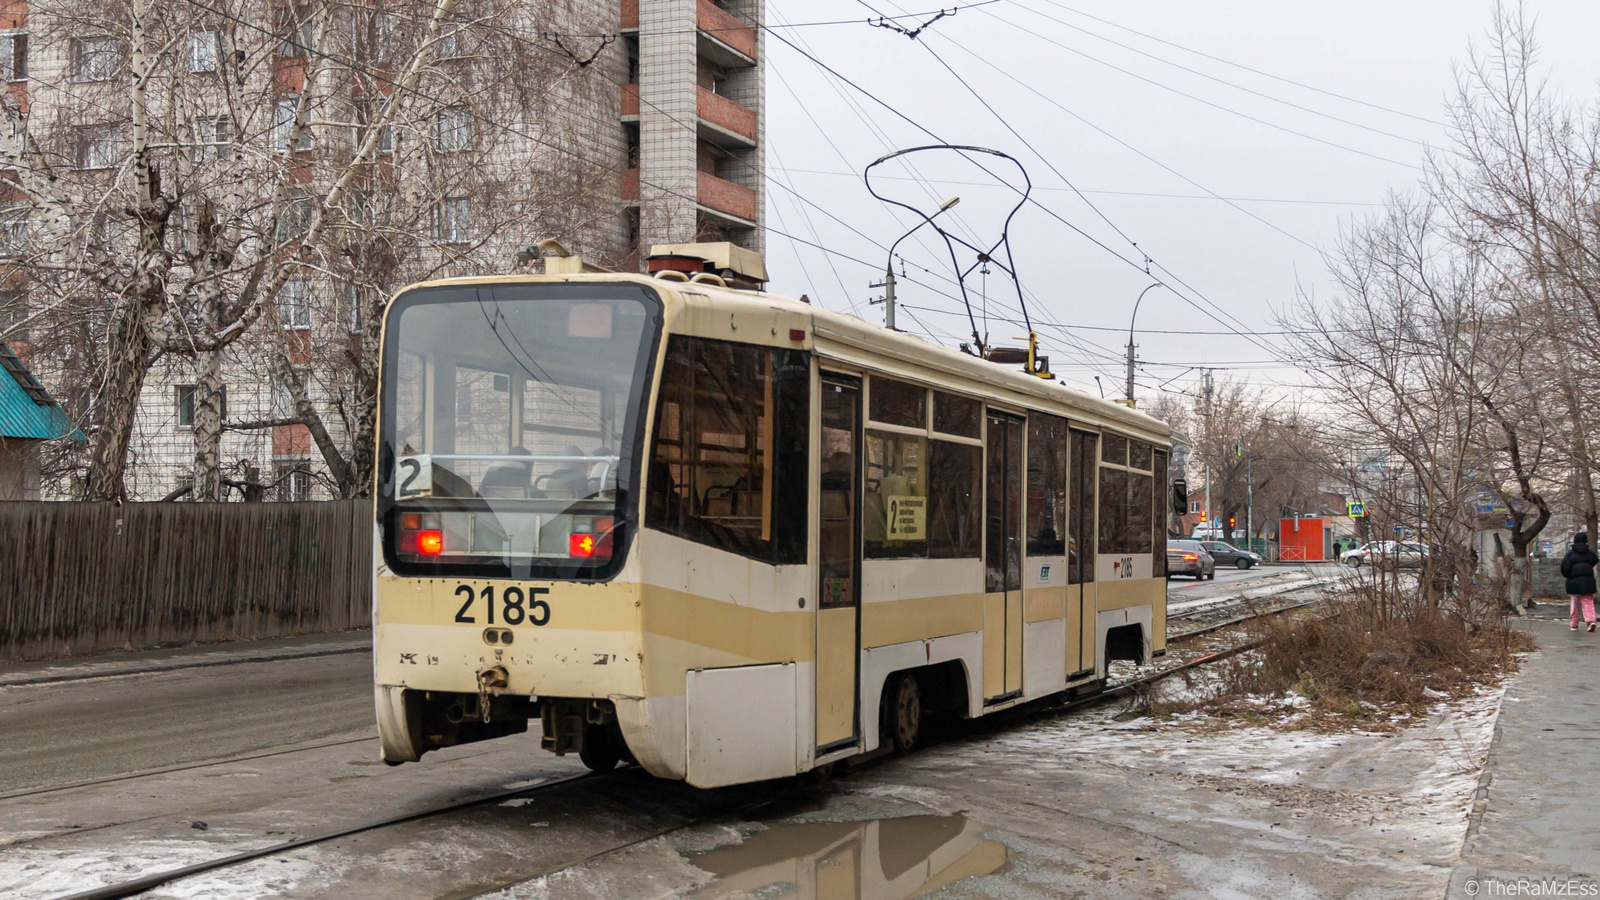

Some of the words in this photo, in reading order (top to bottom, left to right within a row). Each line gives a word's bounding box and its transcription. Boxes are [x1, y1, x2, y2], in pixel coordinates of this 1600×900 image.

[399, 457, 421, 497] 2
[890, 499, 897, 534] 2
[1120, 557, 1132, 579] 2185
[454, 584, 551, 626] 2185
